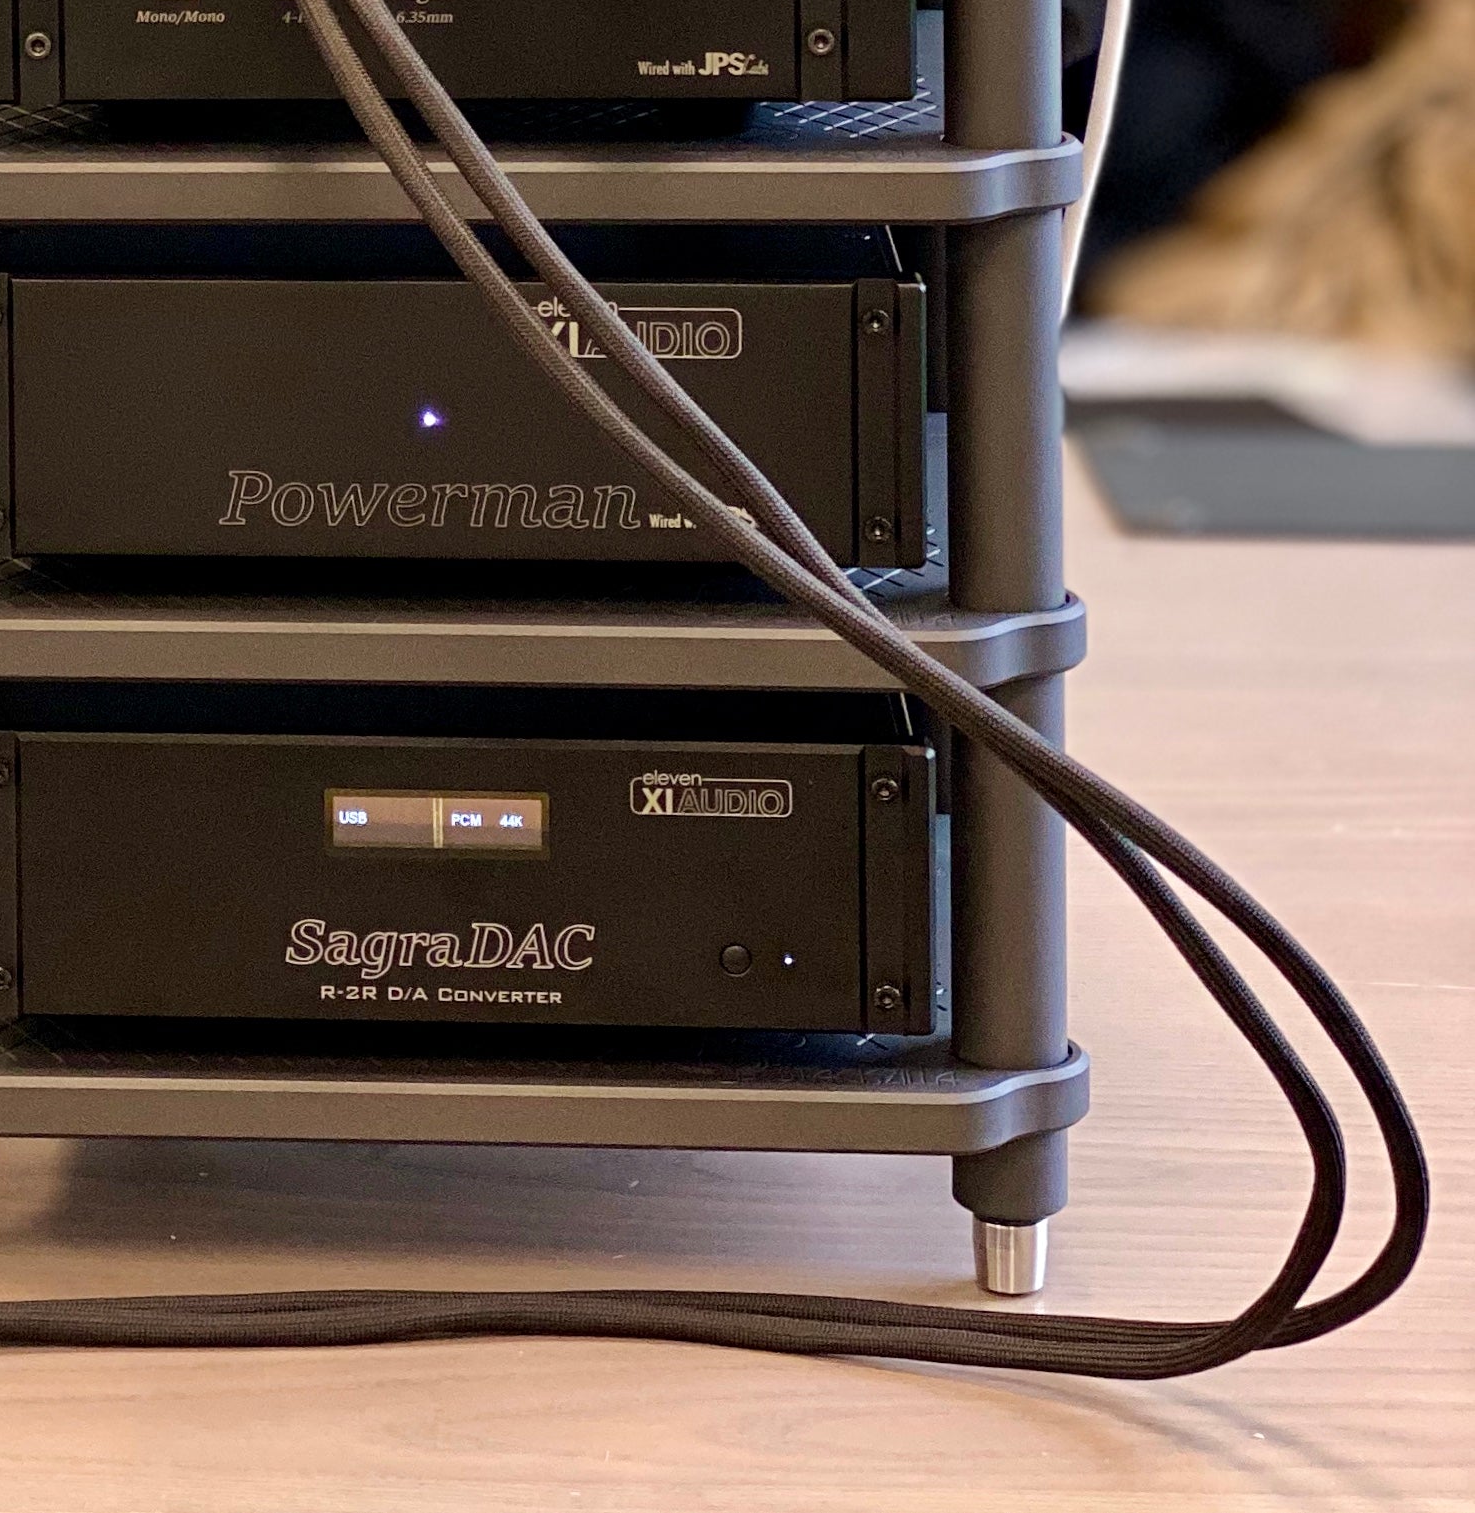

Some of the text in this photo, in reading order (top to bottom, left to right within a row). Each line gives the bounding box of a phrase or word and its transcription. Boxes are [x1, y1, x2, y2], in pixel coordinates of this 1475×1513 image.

[135, 9, 226, 25] Mono/Mono
[396, 10, 454, 24] 6.35mm
[637, 59, 670, 75] Wired
[672, 59, 695, 75] with
[218, 469, 641, 529] Powerman
[649, 513, 681, 529] Wired
[642, 769, 702, 786] eleven
[338, 810, 368, 825] USB
[451, 813, 524, 828] PCM 44K
[285, 918, 595, 980] SagraDAC
[320, 985, 563, 1004] R-2R D/A CONVERTER
